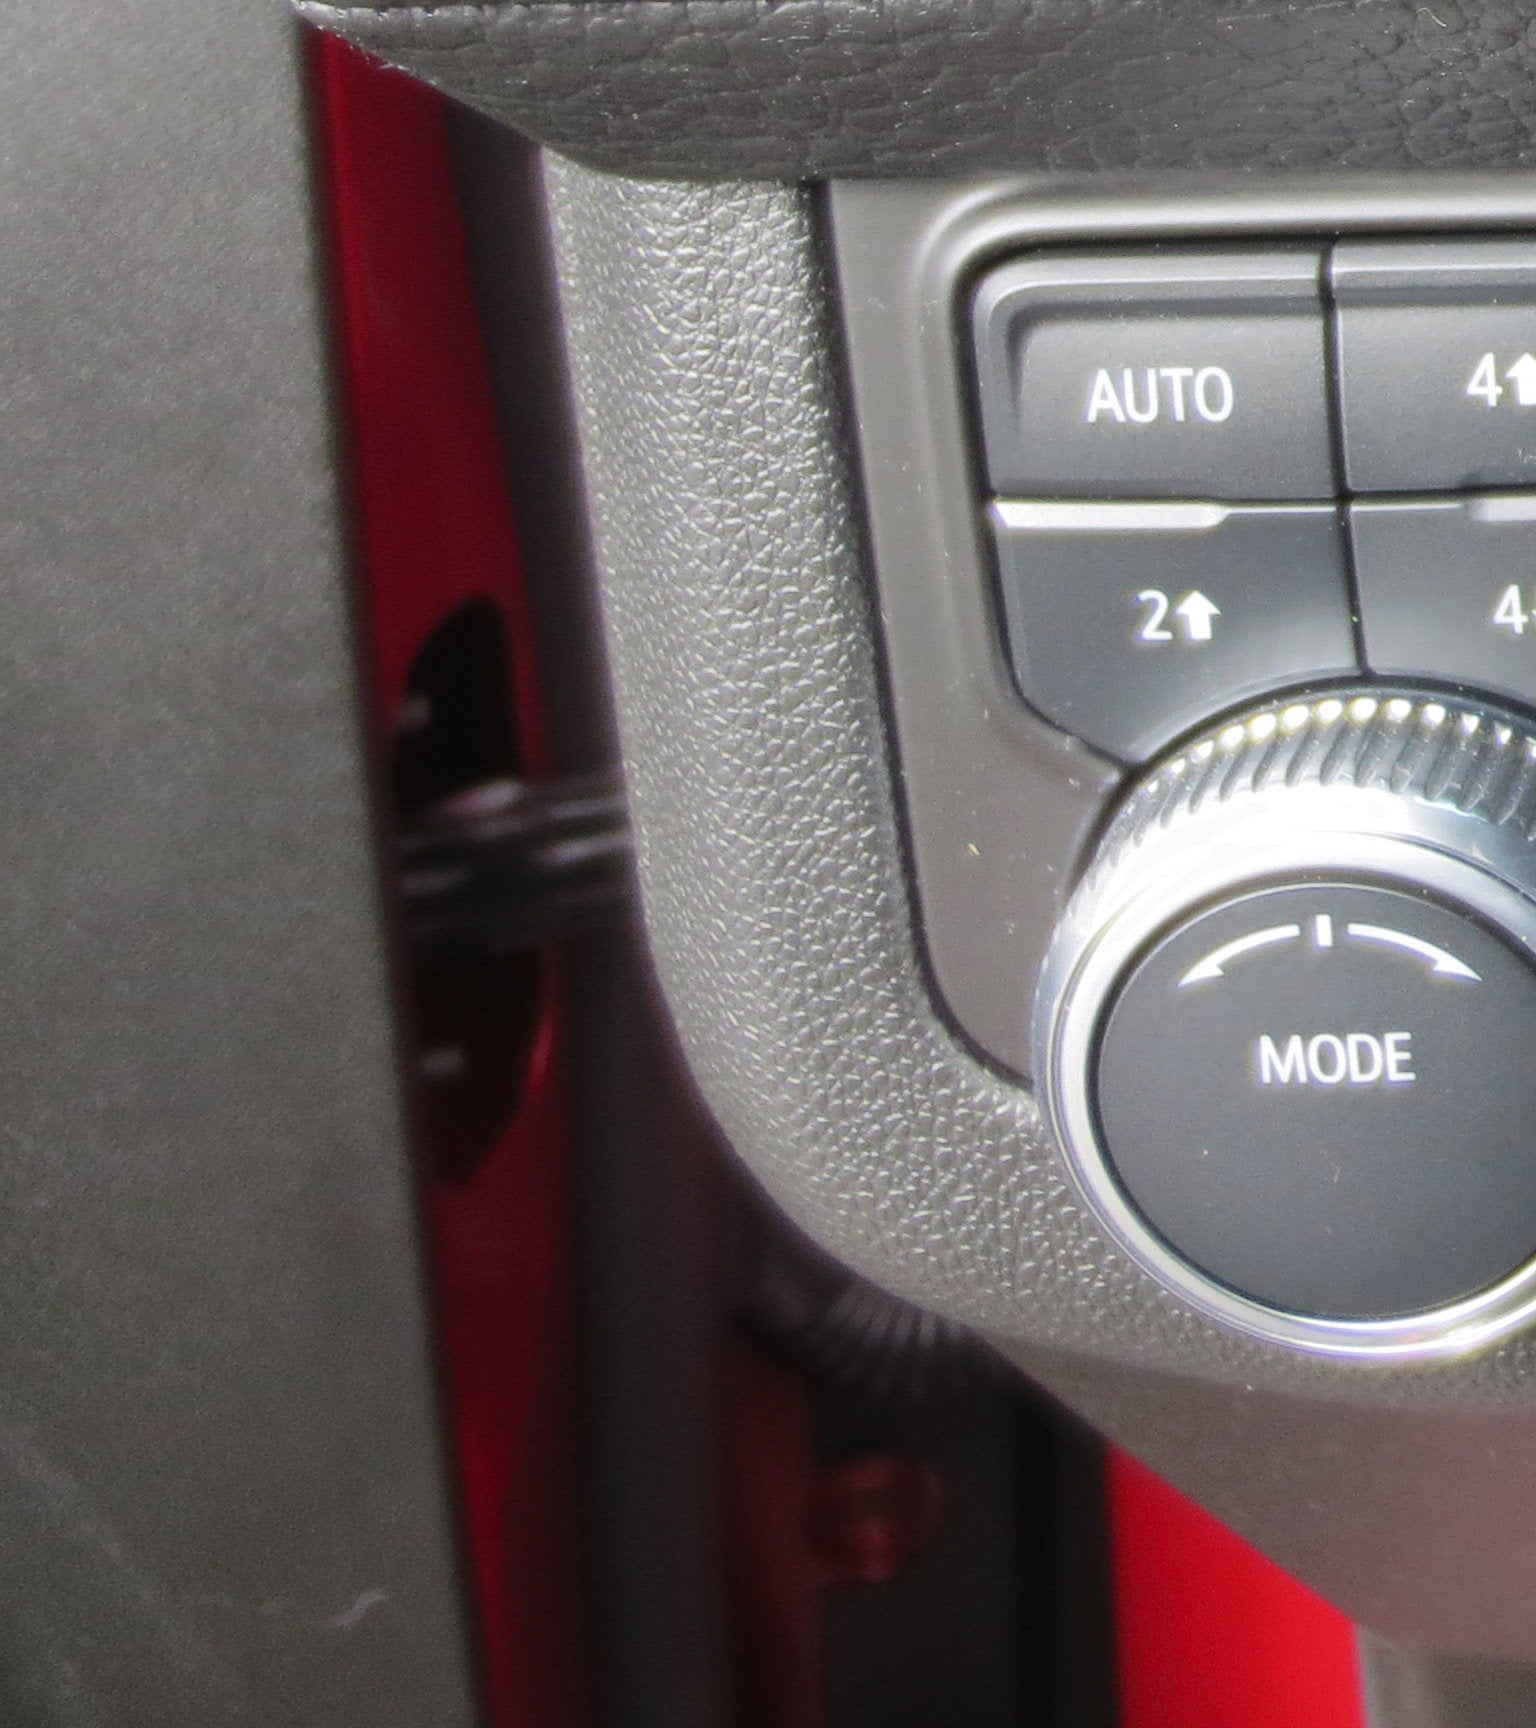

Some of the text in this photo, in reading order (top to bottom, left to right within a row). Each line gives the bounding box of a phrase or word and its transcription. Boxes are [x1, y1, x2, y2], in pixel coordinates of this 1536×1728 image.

[1087, 365, 1234, 423] AUTO
[1466, 352, 1503, 407] 4
[1137, 588, 1173, 641] 2
[1492, 584, 1529, 635] 4
[1258, 1030, 1416, 1085] MODE
